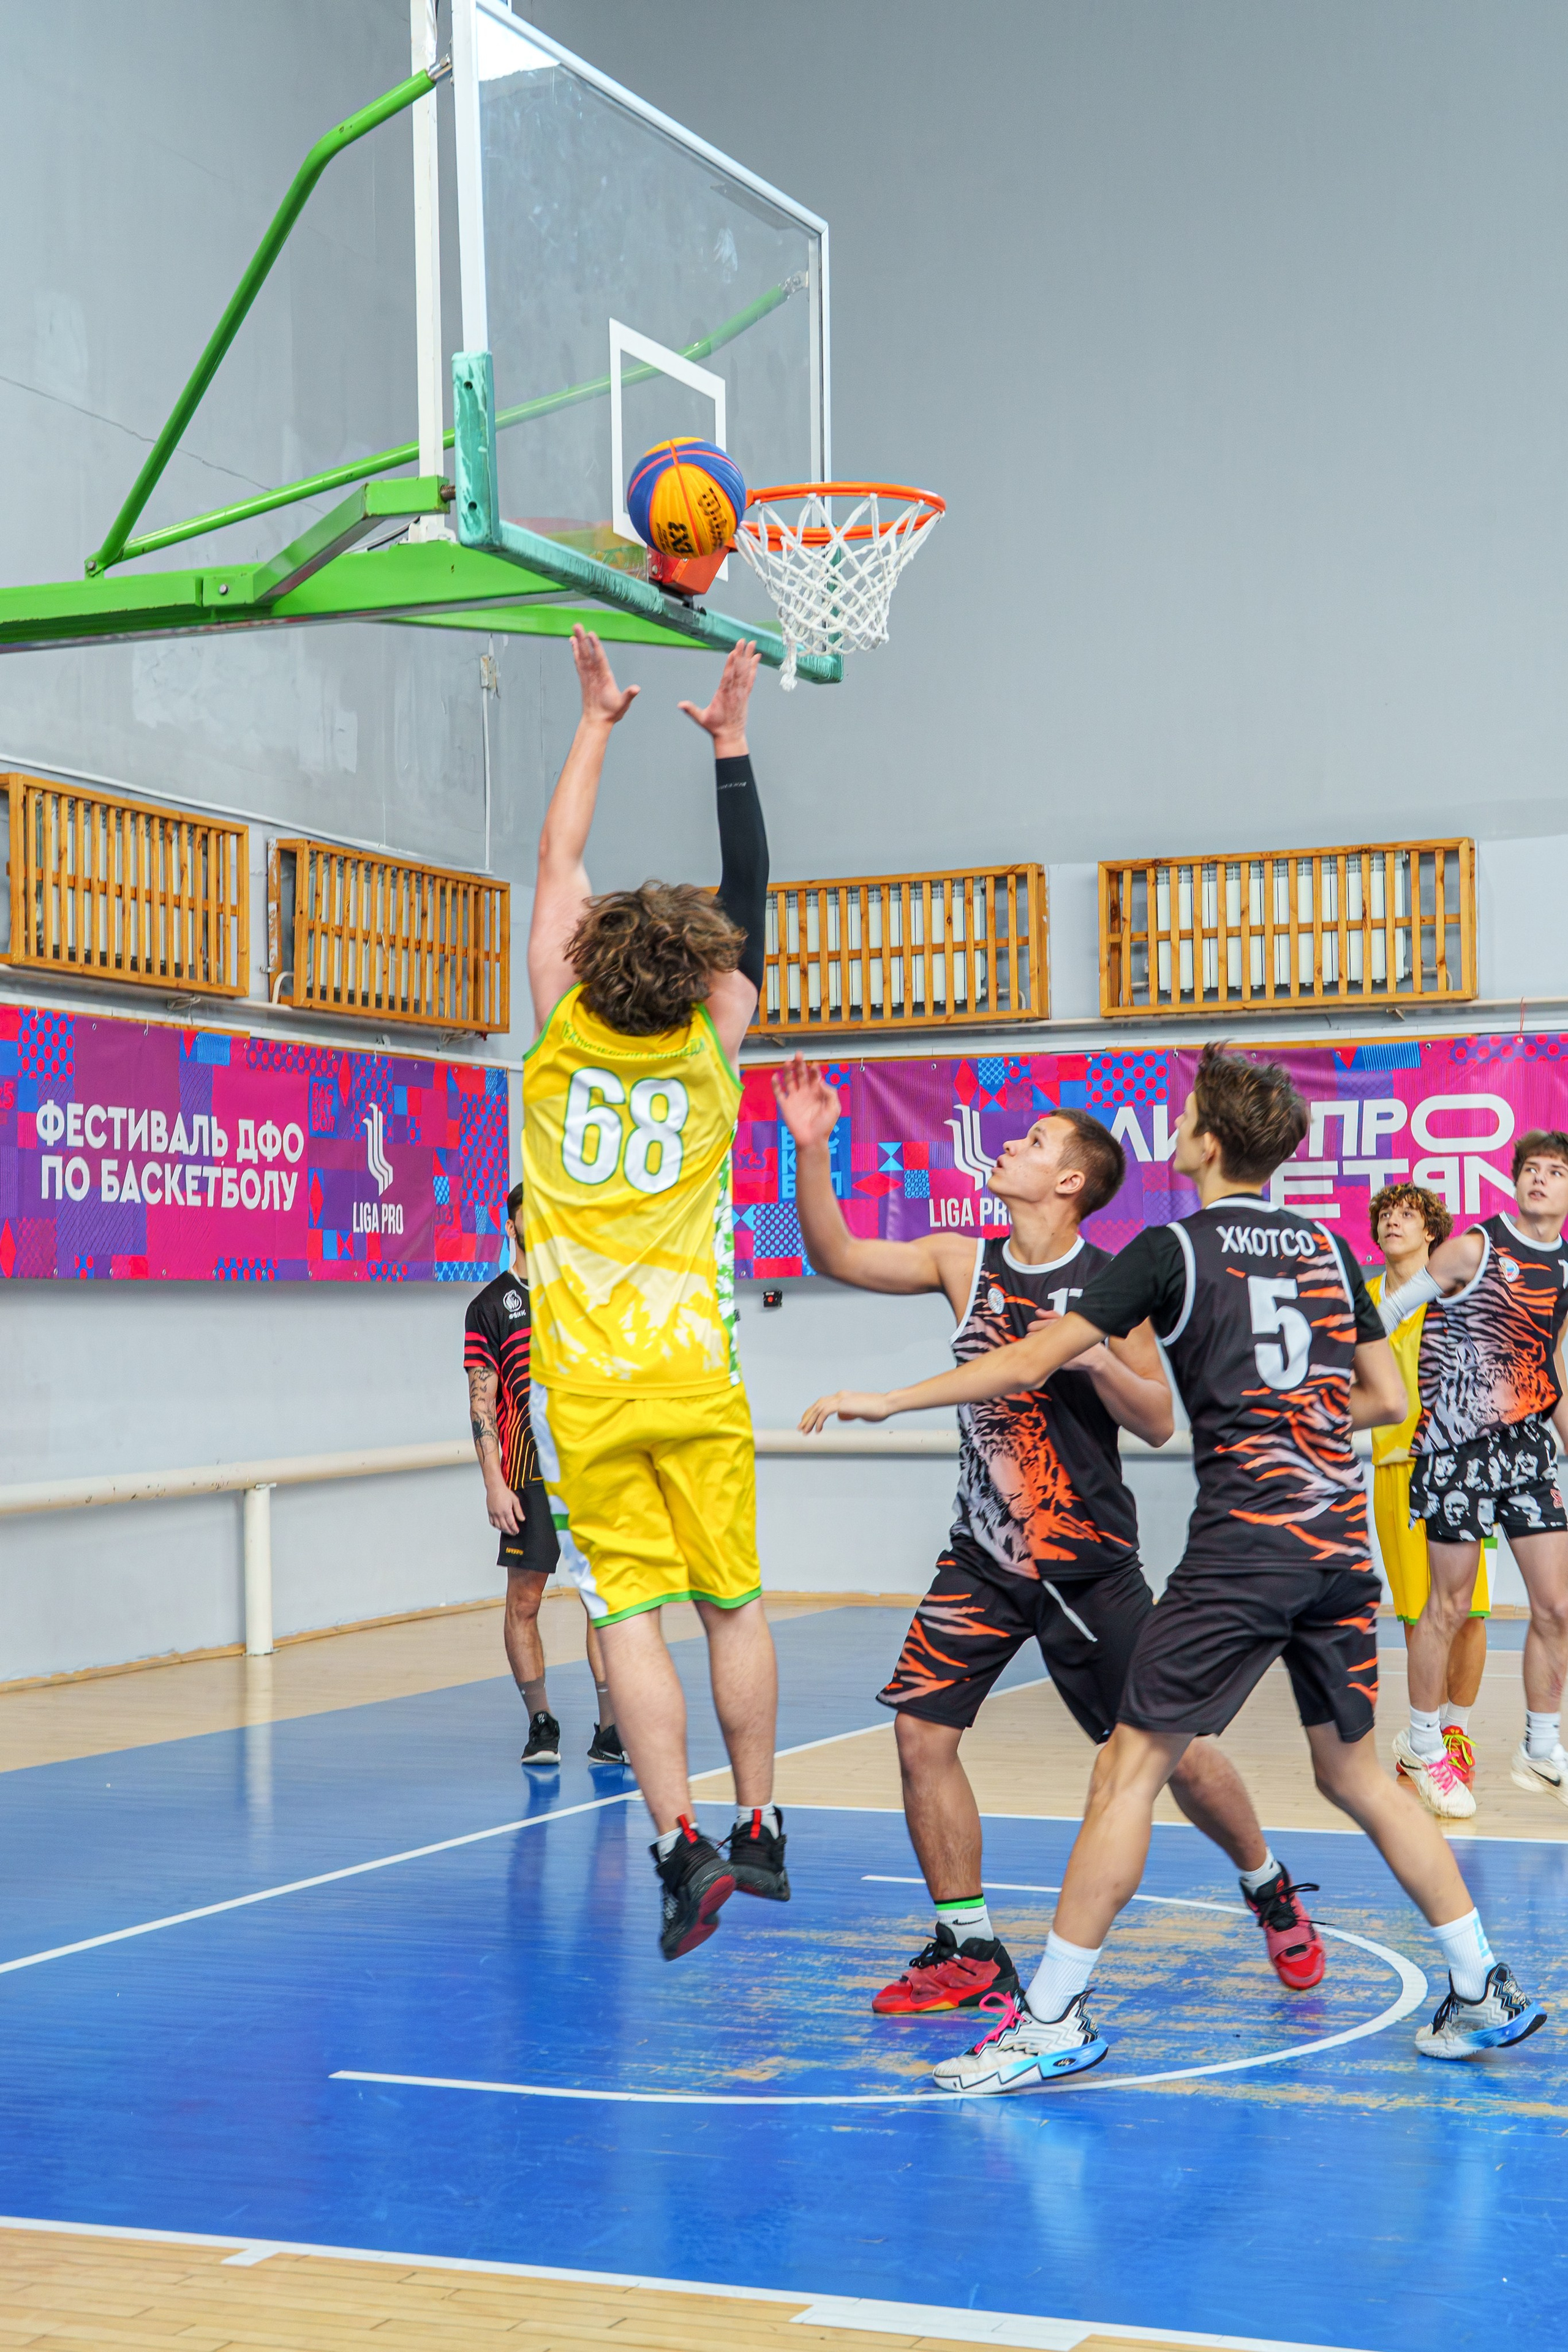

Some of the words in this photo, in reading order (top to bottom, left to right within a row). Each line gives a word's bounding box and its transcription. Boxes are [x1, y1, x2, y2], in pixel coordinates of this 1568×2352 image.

[36, 1099, 228, 1157] ФЕСТИВАЛЬ
[236, 1119, 304, 1164] ДФО
[561, 1066, 689, 1194] 68
[1308, 1093, 1515, 1158] ПРО
[41, 1155, 90, 1202] ПО
[101, 1158, 298, 1211] БАСКЕТБОЛУ
[929, 1197, 975, 1227] LIGA
[979, 1196, 1013, 1226] PR
[353, 1202, 380, 1233] LIGA
[381, 1203, 404, 1235] PRO
[1247, 1275, 1313, 1390] 5
